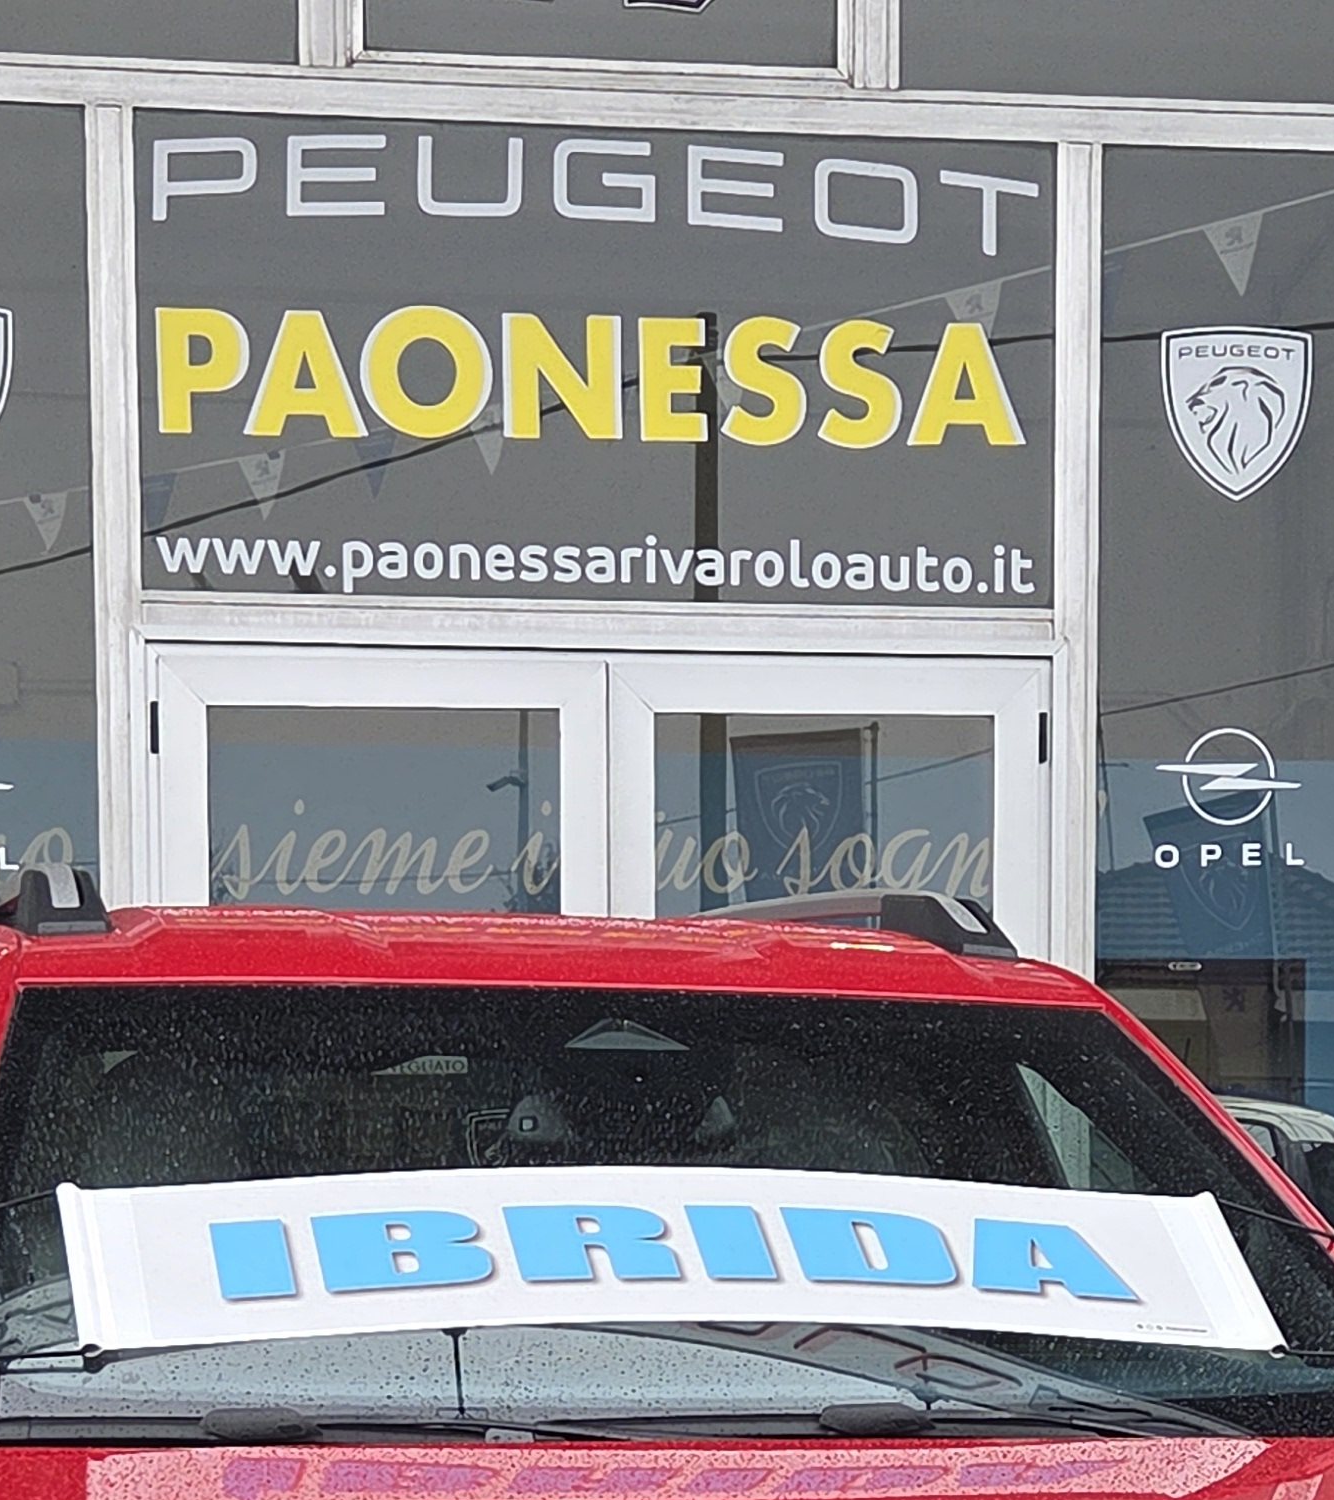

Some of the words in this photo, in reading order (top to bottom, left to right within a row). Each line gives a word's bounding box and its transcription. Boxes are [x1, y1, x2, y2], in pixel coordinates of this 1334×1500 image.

[151, 134, 1039, 256] PEUGEOT
[154, 305, 1026, 449] PAONESSA
[1178, 344, 1297, 361] PEUGEOT
[157, 534, 1035, 594] www.paonessarivaroloauto.it
[212, 798, 493, 900] sieme
[776, 825, 990, 897] sogn
[1154, 843, 1305, 868] OPEL
[208, 1204, 1140, 1303] IBRIDA
